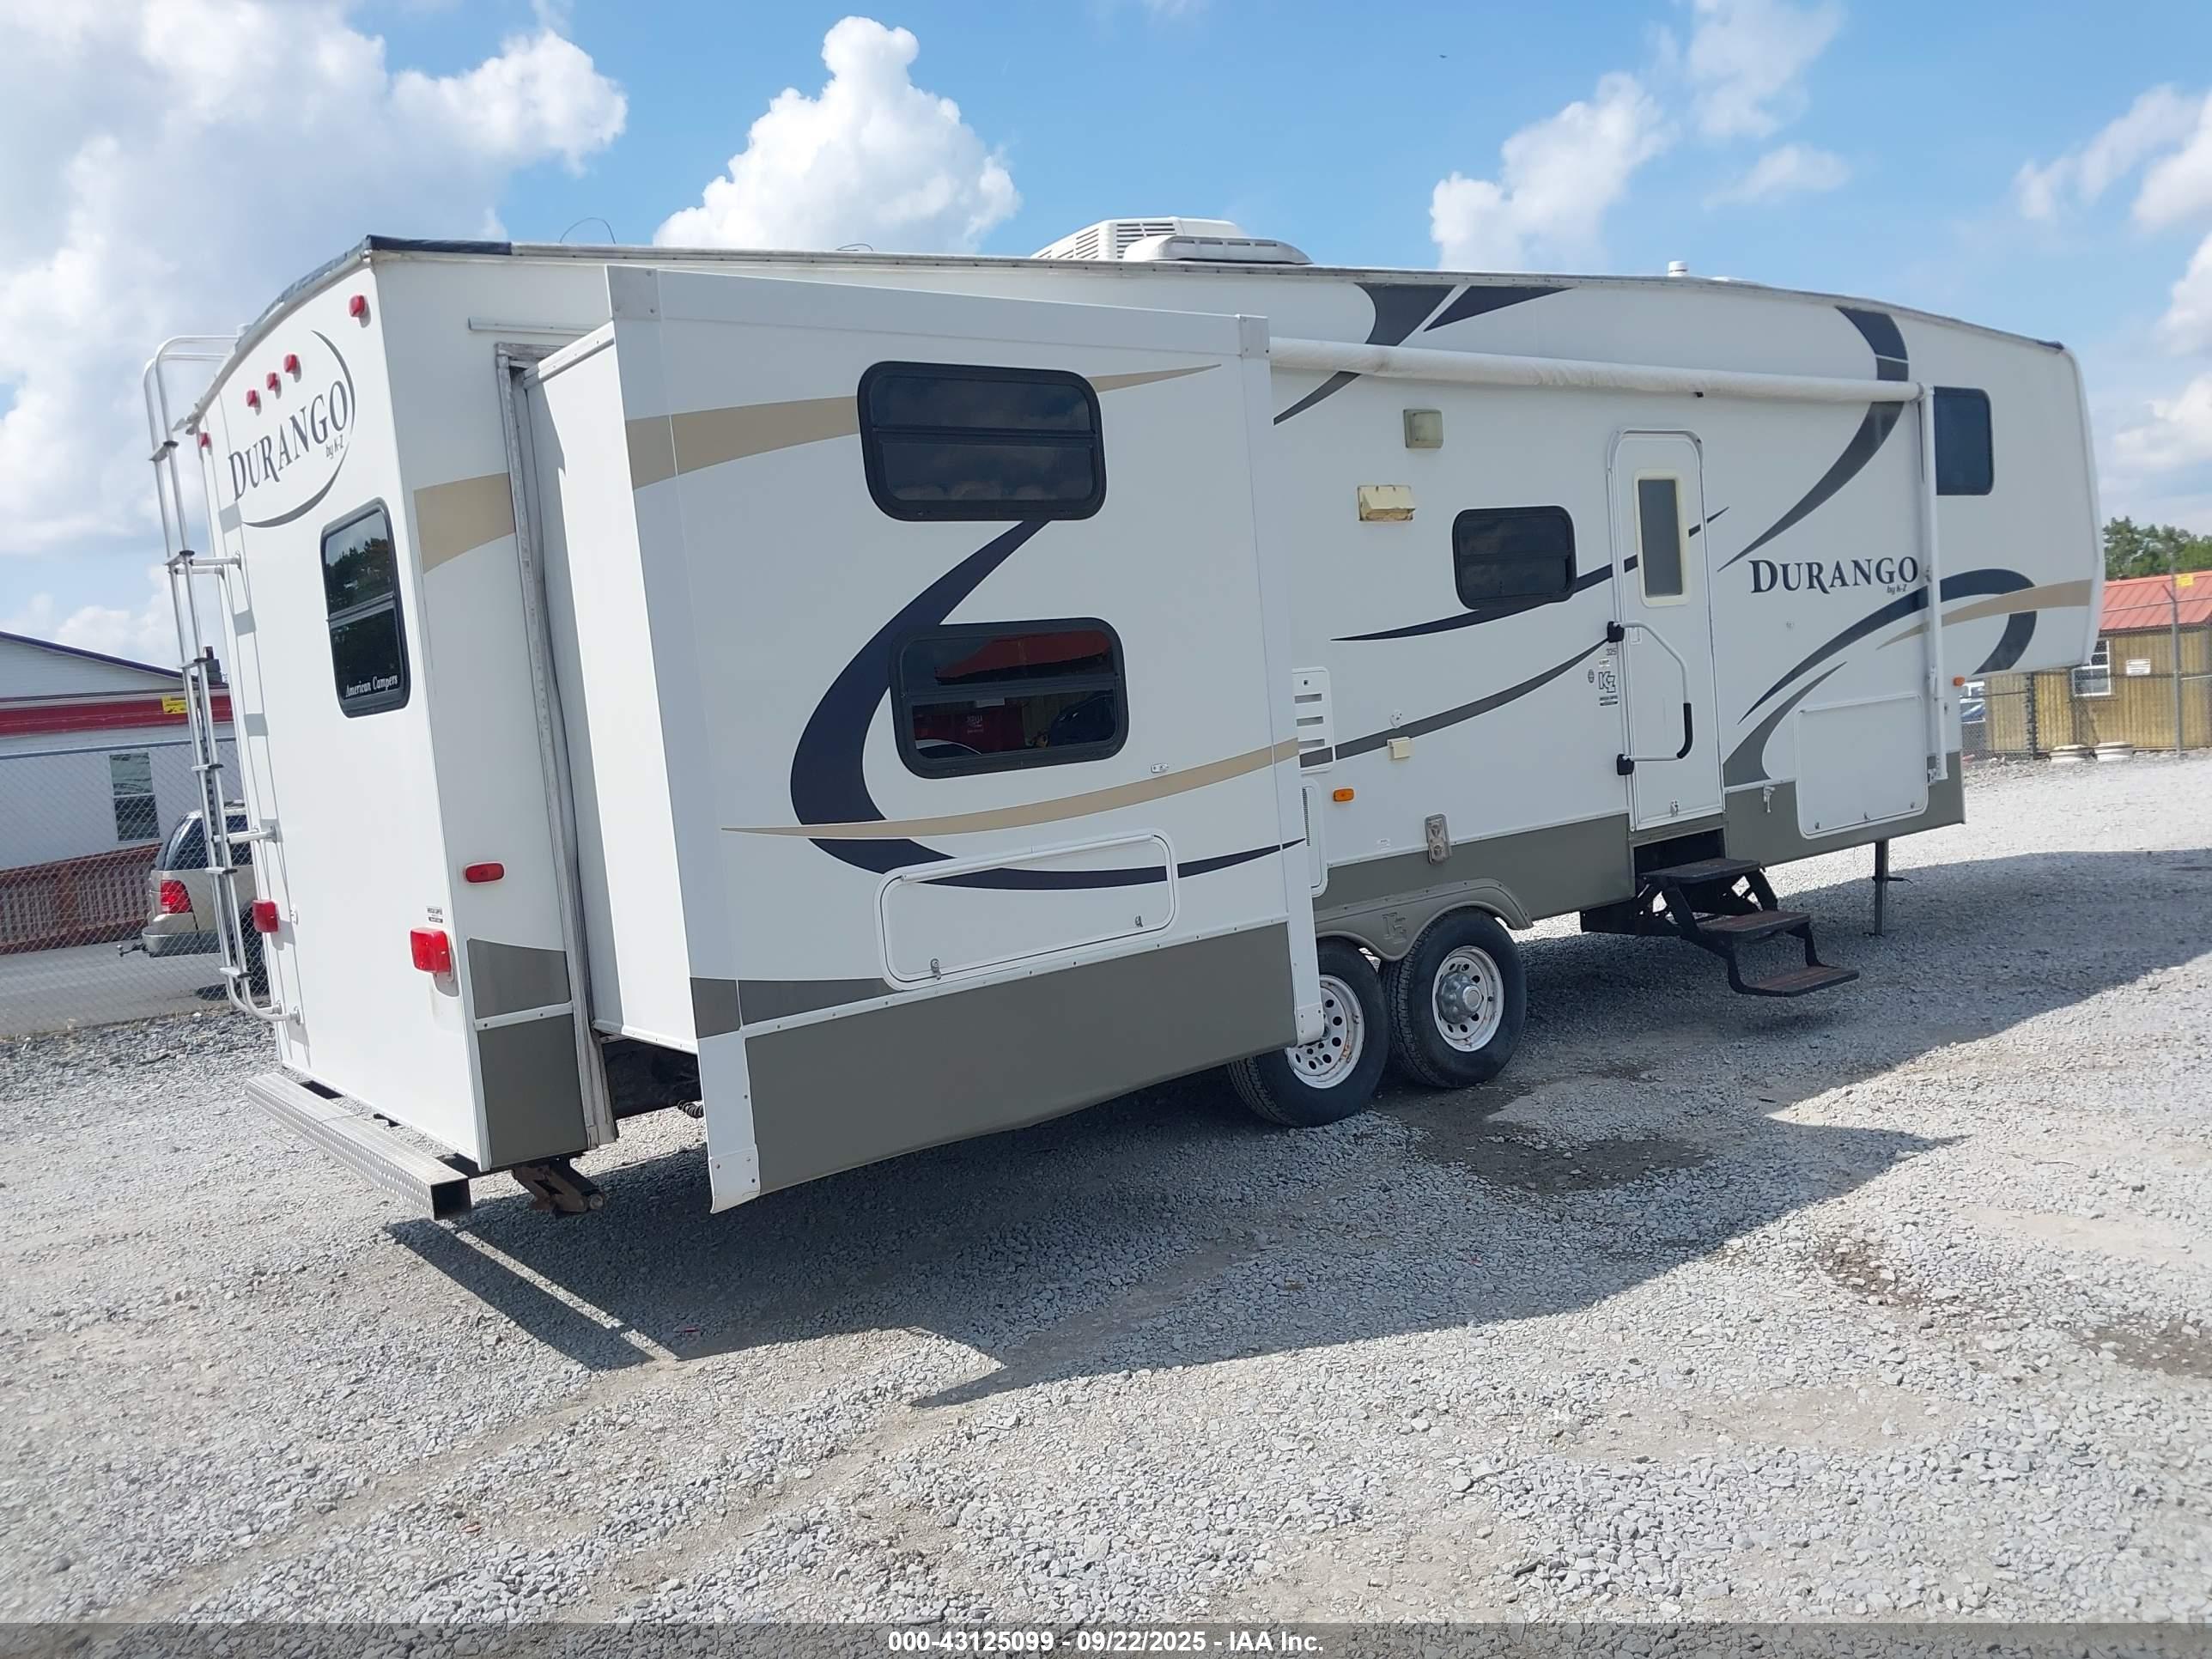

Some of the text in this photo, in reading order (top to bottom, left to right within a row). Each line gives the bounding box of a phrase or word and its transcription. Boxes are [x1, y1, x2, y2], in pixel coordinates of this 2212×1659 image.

[228, 380, 348, 501] DURANGO
[325, 444, 334, 459] by
[1748, 556, 1918, 594] DURANGO
[1887, 585, 1896, 595] by
[345, 674, 398, 698] American Campers
